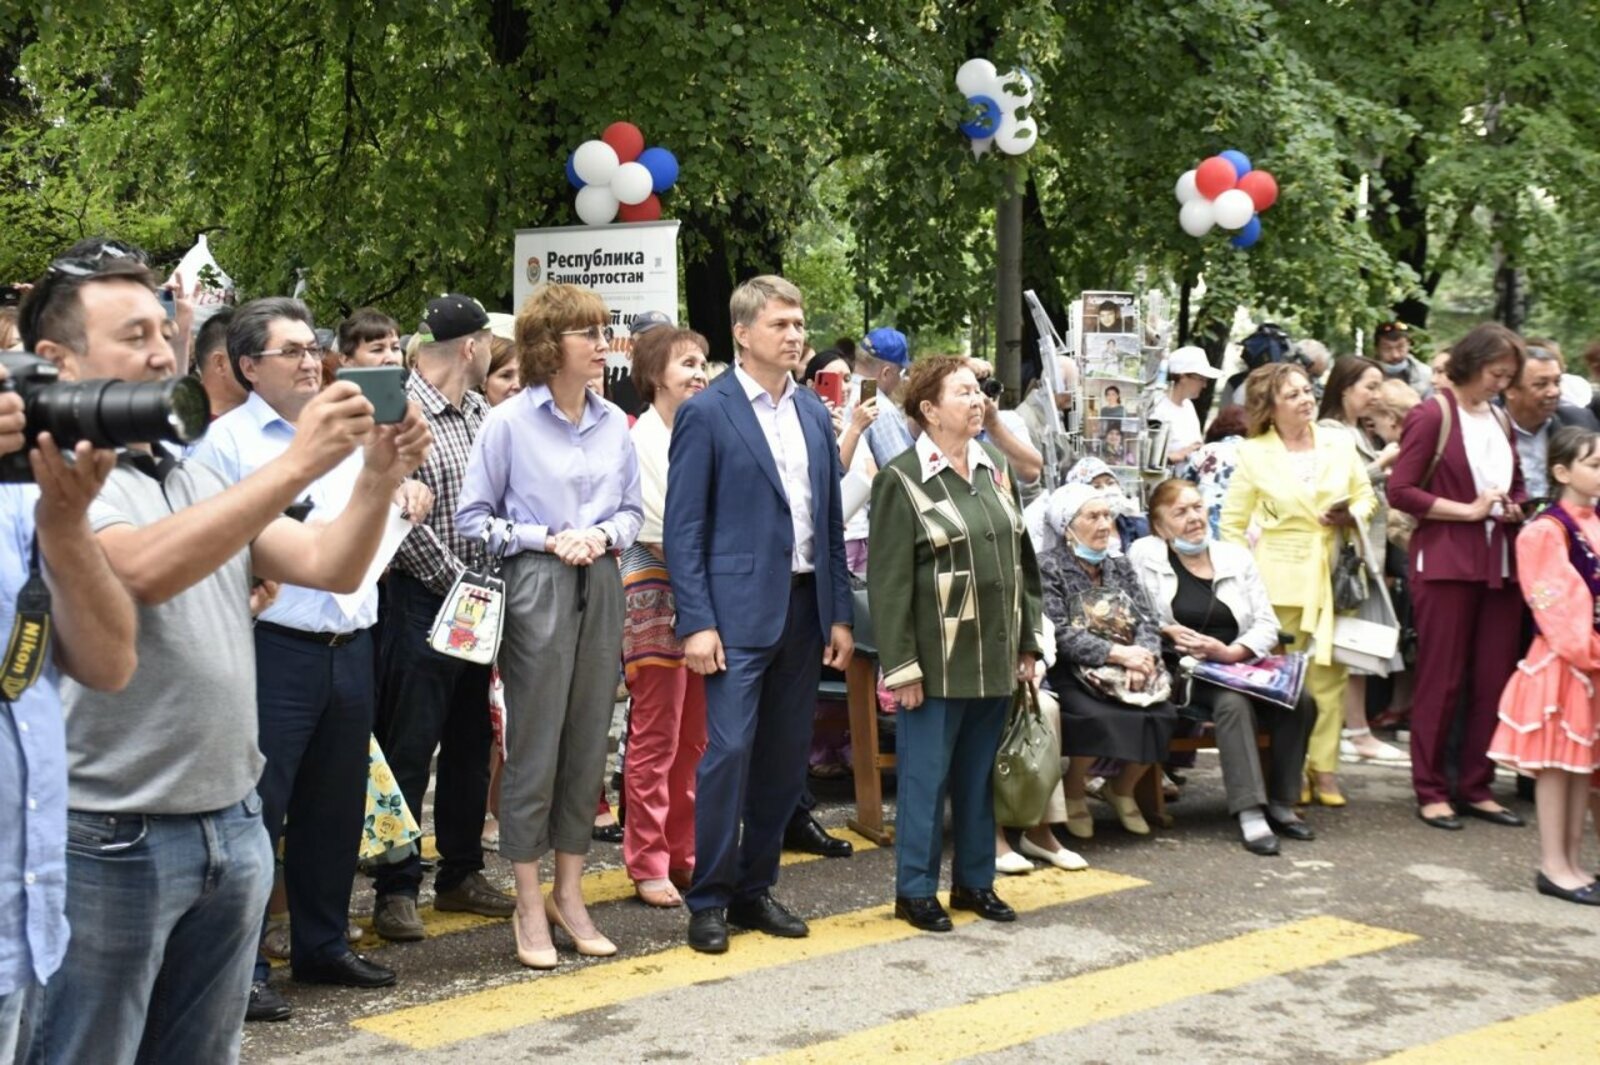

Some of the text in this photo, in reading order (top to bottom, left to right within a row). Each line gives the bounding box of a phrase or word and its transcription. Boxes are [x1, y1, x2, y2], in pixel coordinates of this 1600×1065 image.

[547, 248, 645, 271] Республика
[547, 270, 644, 288] Башкортостан
[12, 622, 41, 674] Nikon
